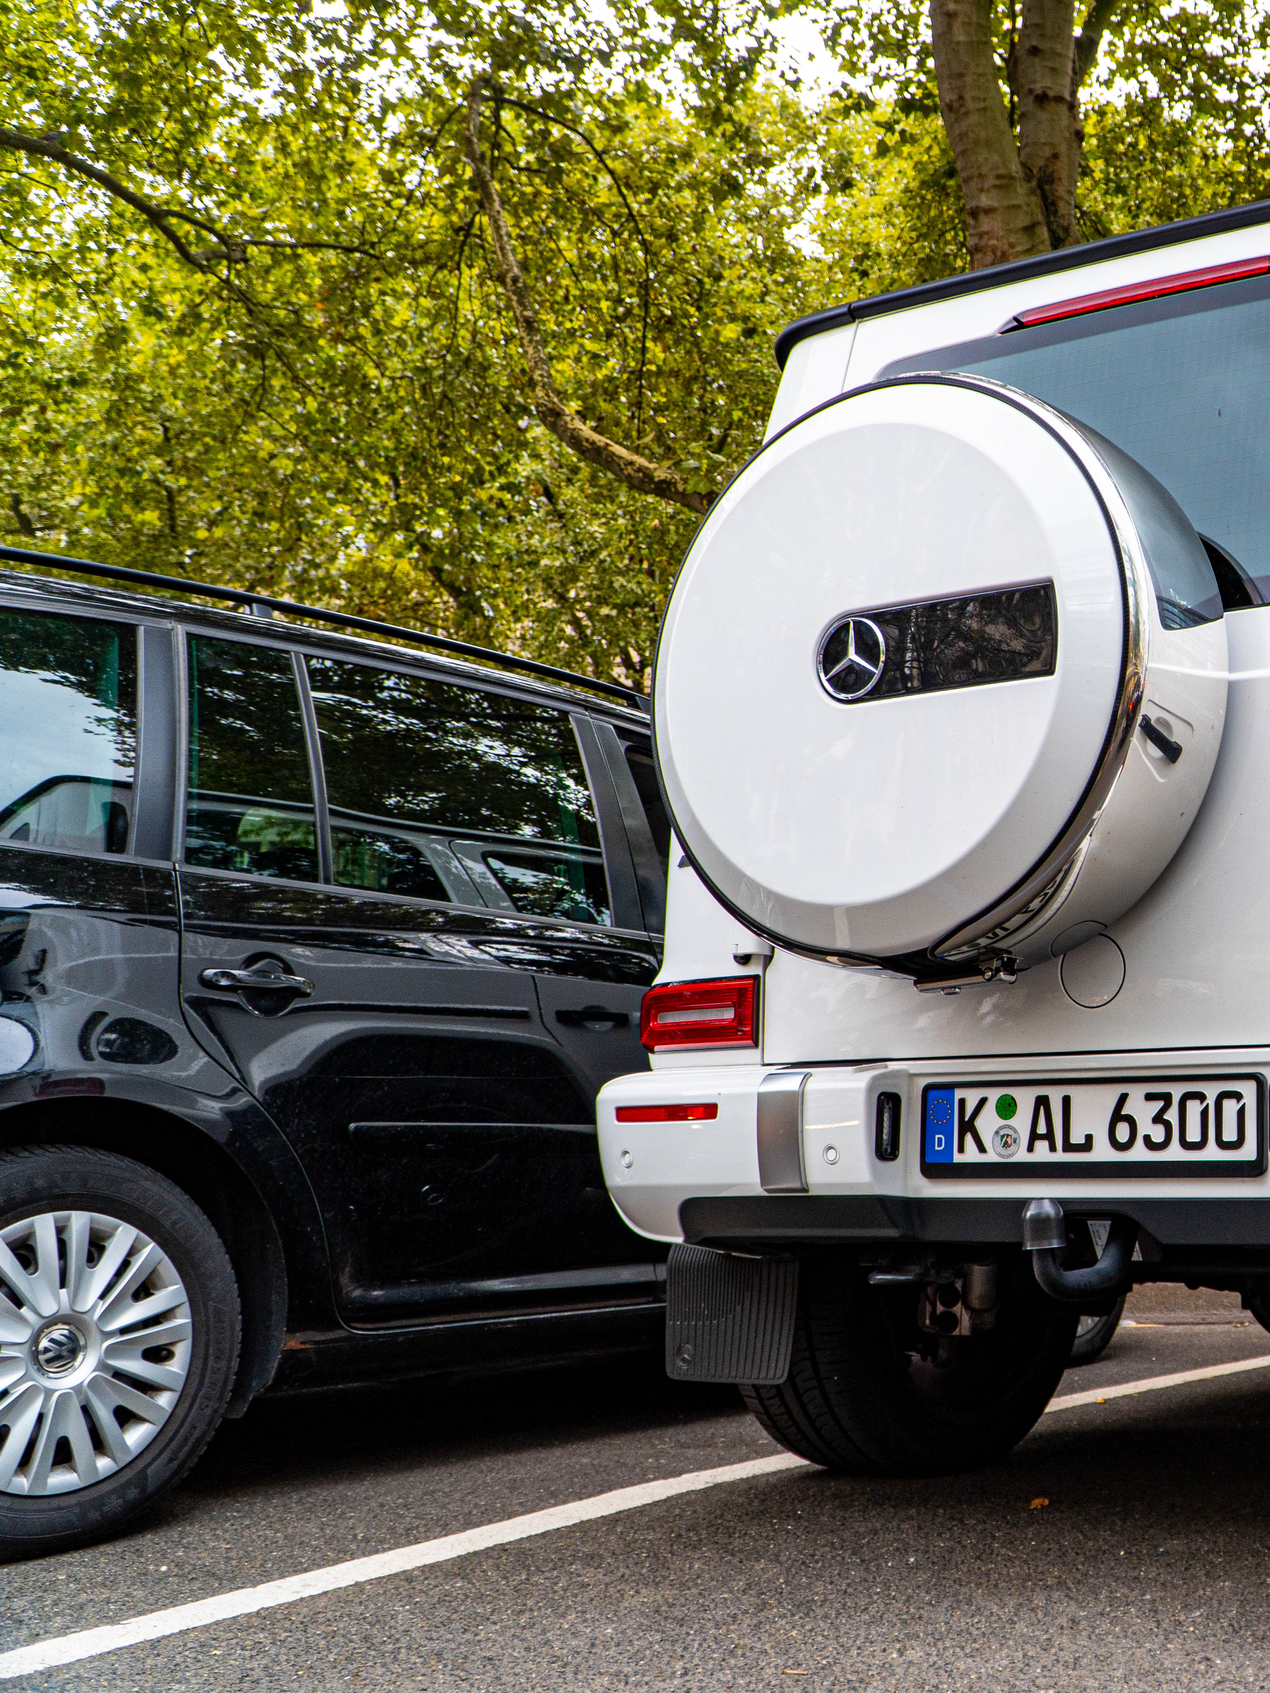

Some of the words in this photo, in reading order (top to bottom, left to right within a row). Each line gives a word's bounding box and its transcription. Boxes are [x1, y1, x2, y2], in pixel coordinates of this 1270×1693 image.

[934, 1134, 945, 1150] D
[957, 1096, 988, 1154] K
[1026, 1094, 1094, 1153] AL
[1107, 1090, 1247, 1152] 6300
